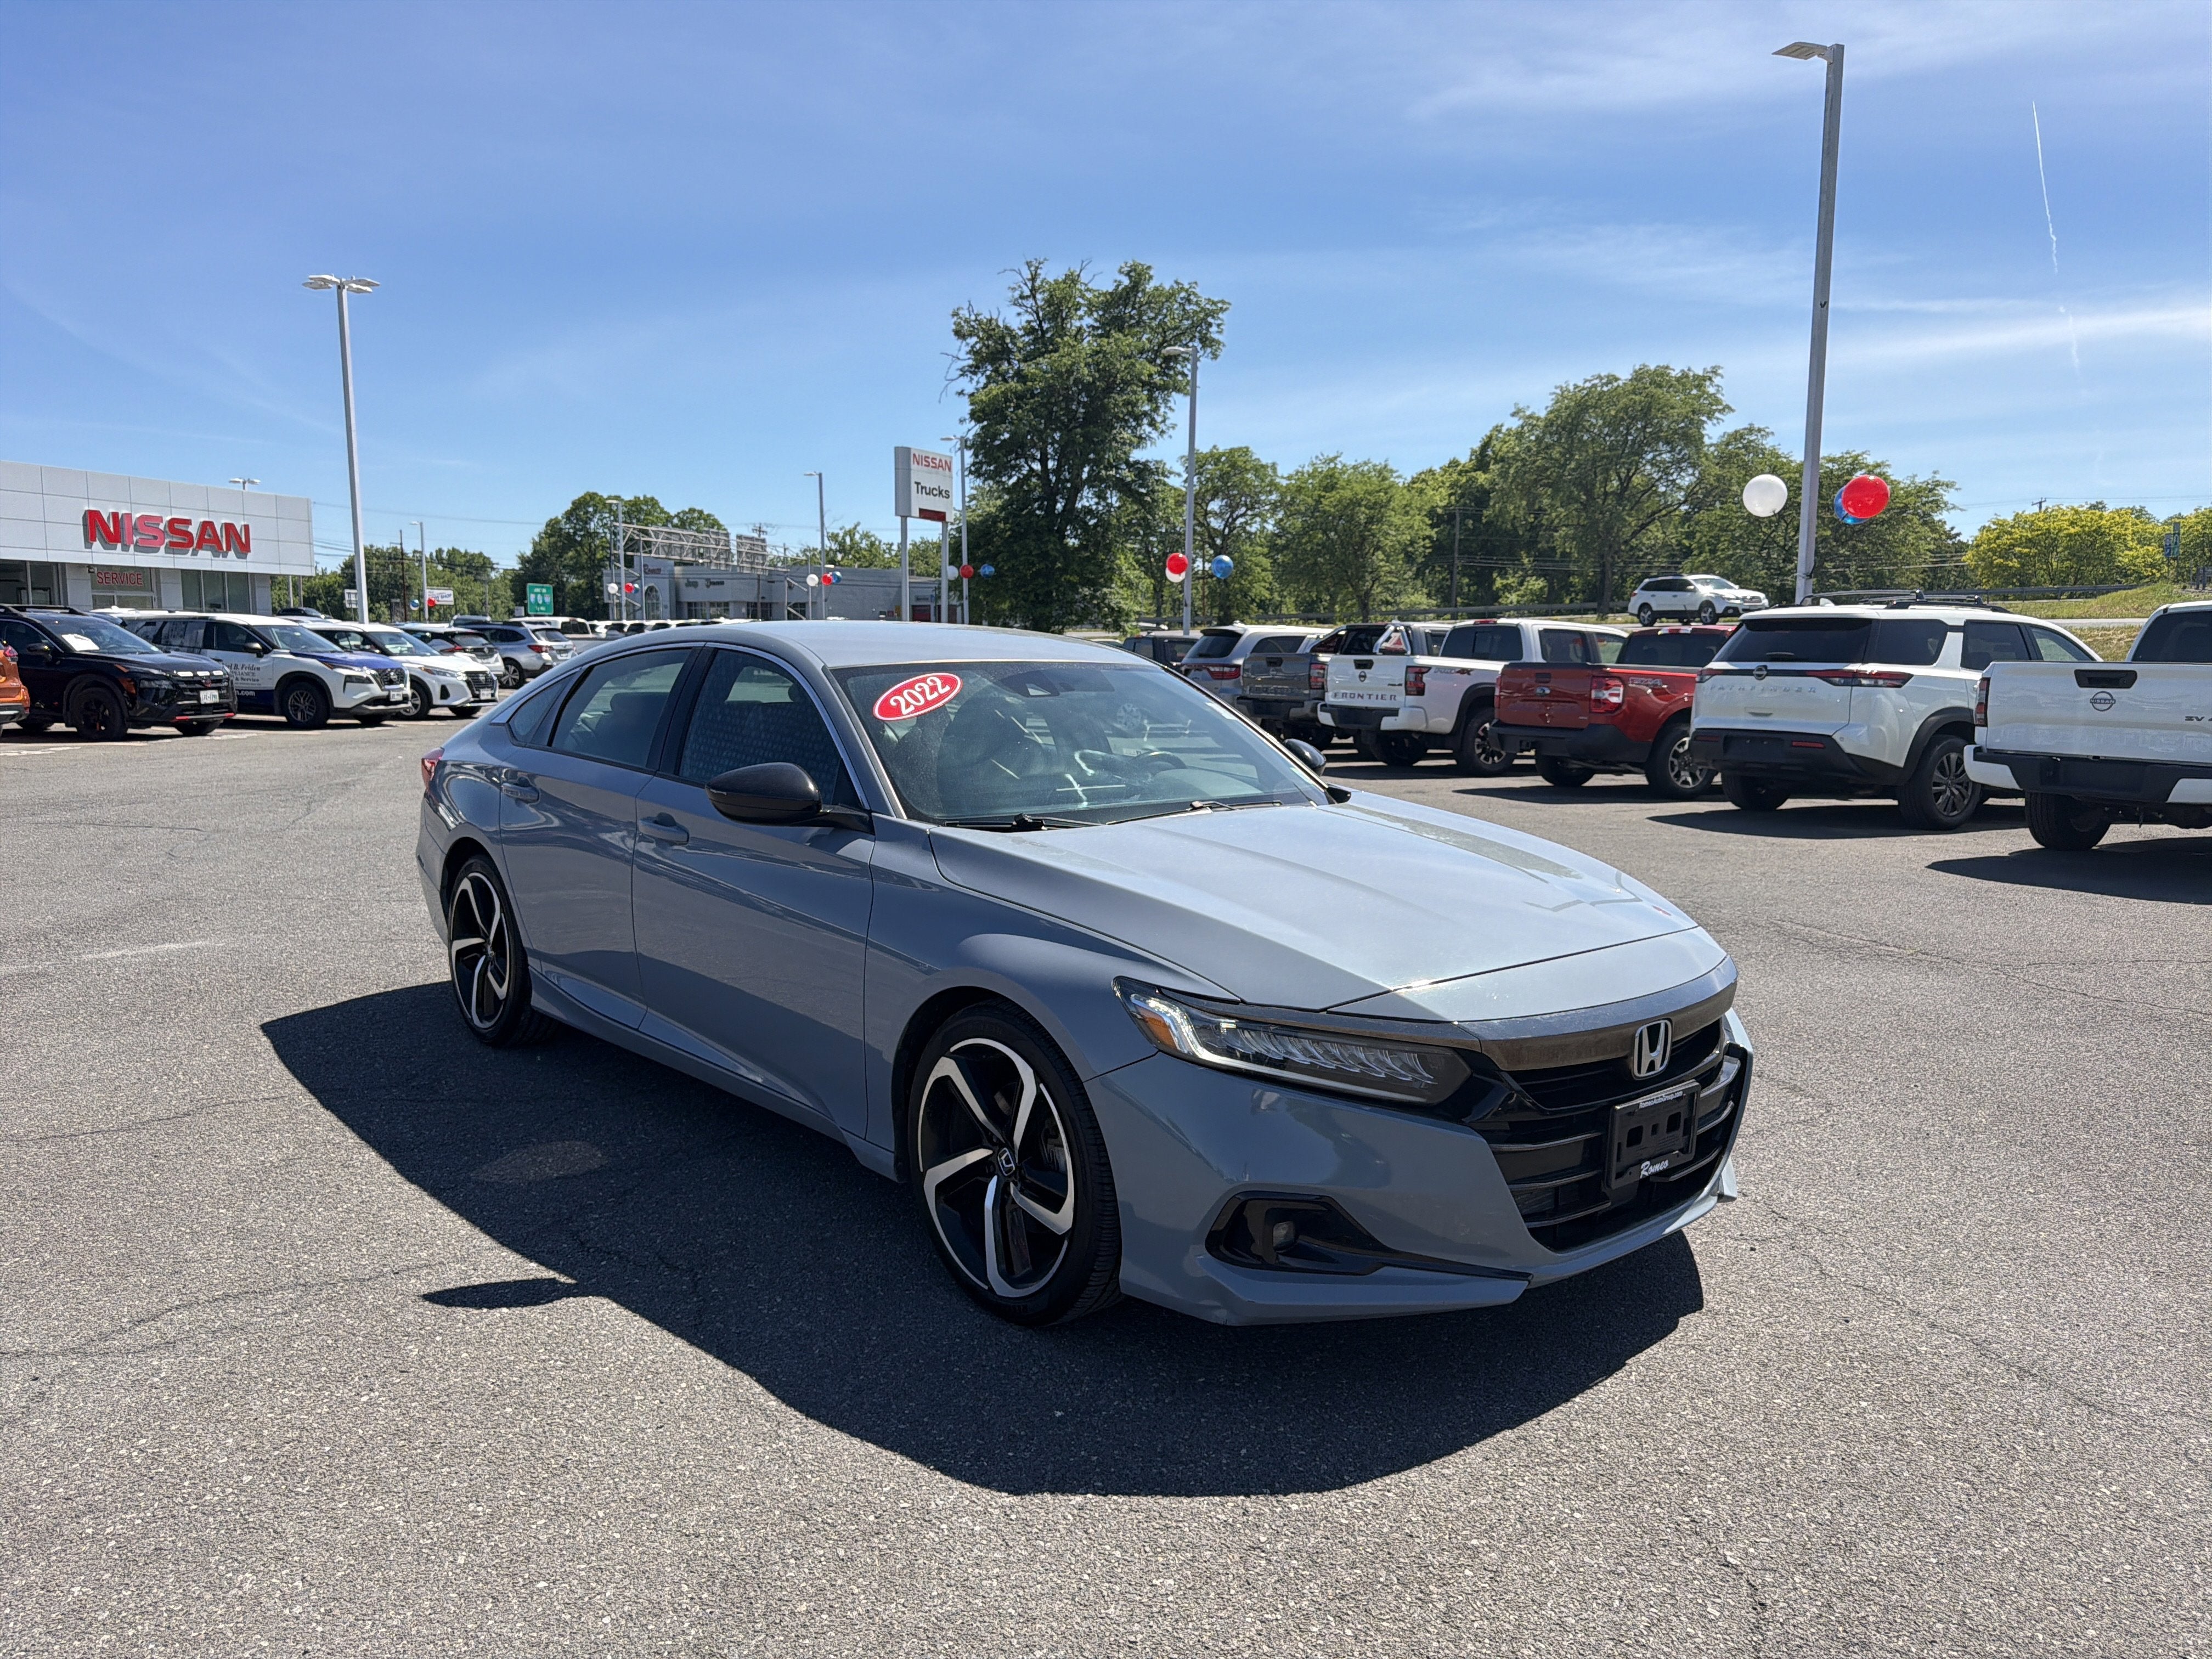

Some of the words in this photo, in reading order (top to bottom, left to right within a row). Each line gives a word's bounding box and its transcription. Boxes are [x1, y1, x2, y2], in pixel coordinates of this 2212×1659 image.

[912, 453, 951, 472] NISSAN
[915, 481, 950, 499] Trucks
[86, 509, 251, 553] NISSAN
[97, 571, 143, 585] SERVICE
[889, 676, 951, 715] 2022
[1334, 692, 1397, 701] FRONTIER
[1639, 1091, 1683, 1109] RomeoAutoGroup.com
[1639, 1159, 1669, 1179] Romeo
